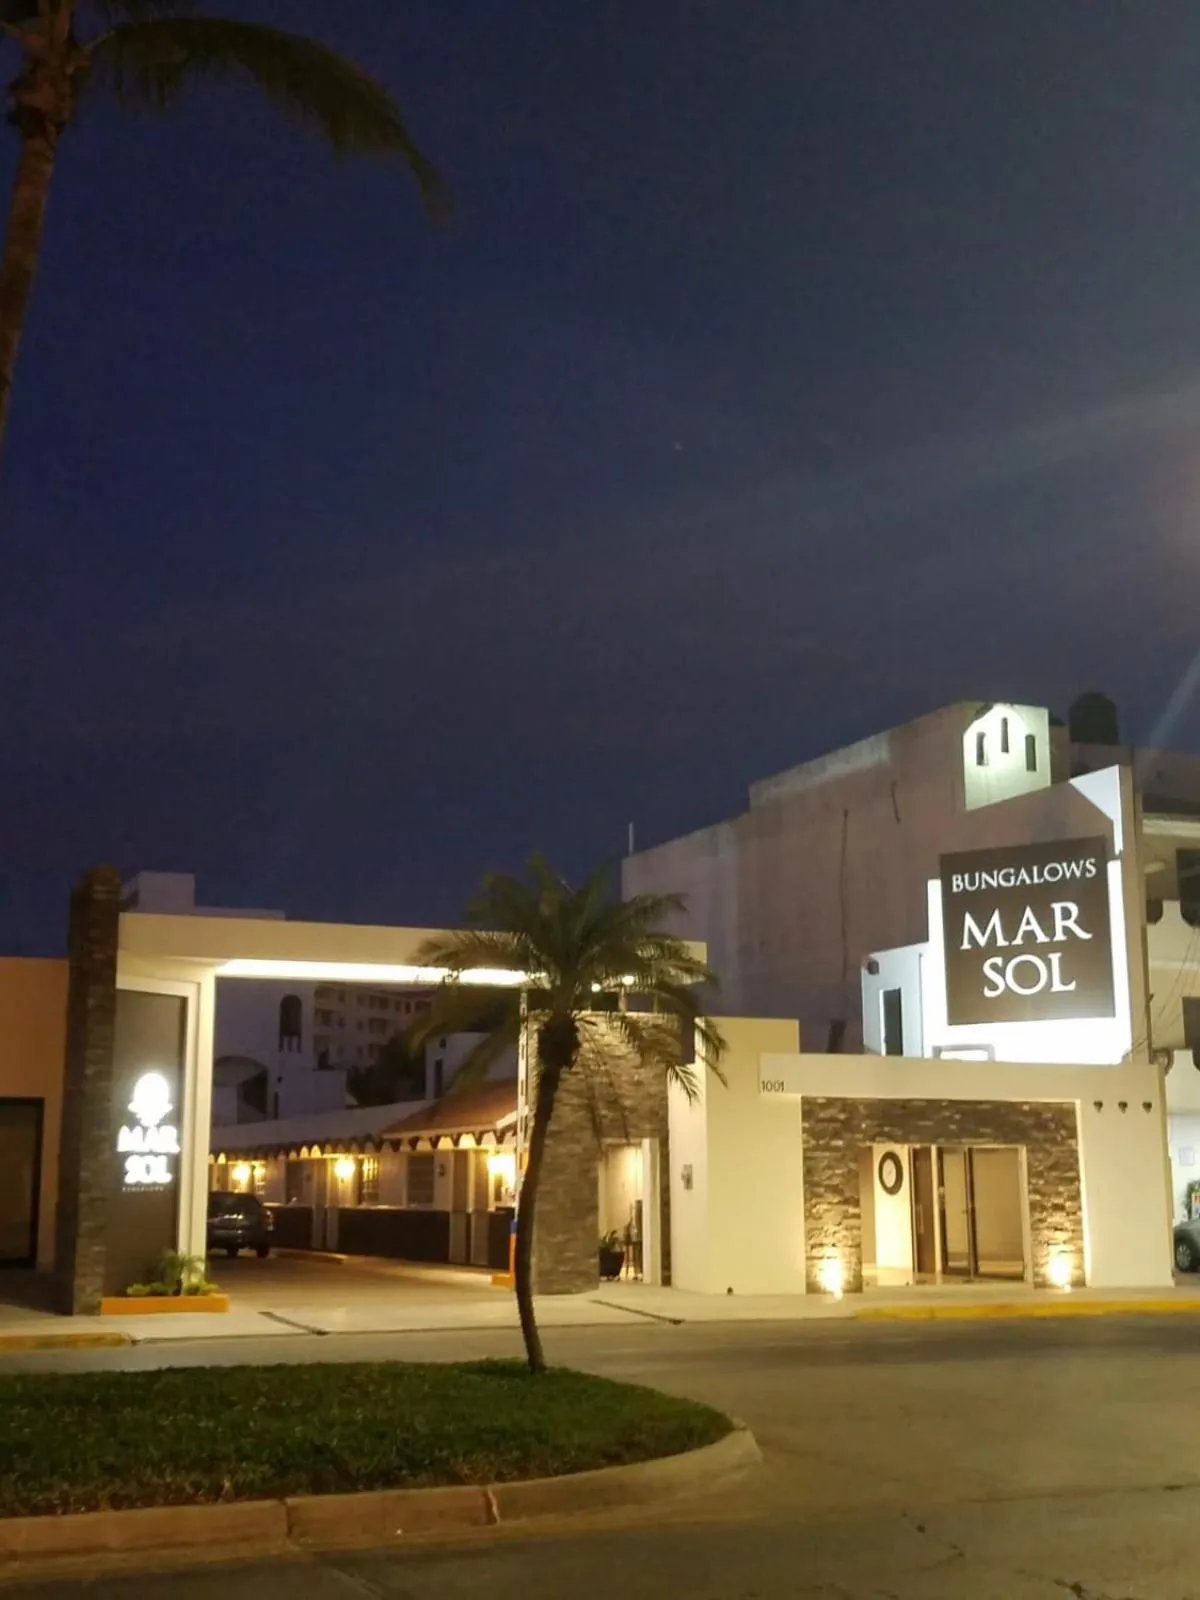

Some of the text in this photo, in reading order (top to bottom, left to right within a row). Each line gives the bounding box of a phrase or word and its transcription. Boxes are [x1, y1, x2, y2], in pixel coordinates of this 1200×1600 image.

[952, 858, 1097, 892] BUNGALOWS
[960, 901, 1093, 950] MAR
[982, 952, 1076, 998] SOL
[762, 1080, 785, 1092] 1001
[117, 1124, 181, 1154] MAR
[124, 1154, 173, 1184] SOL
